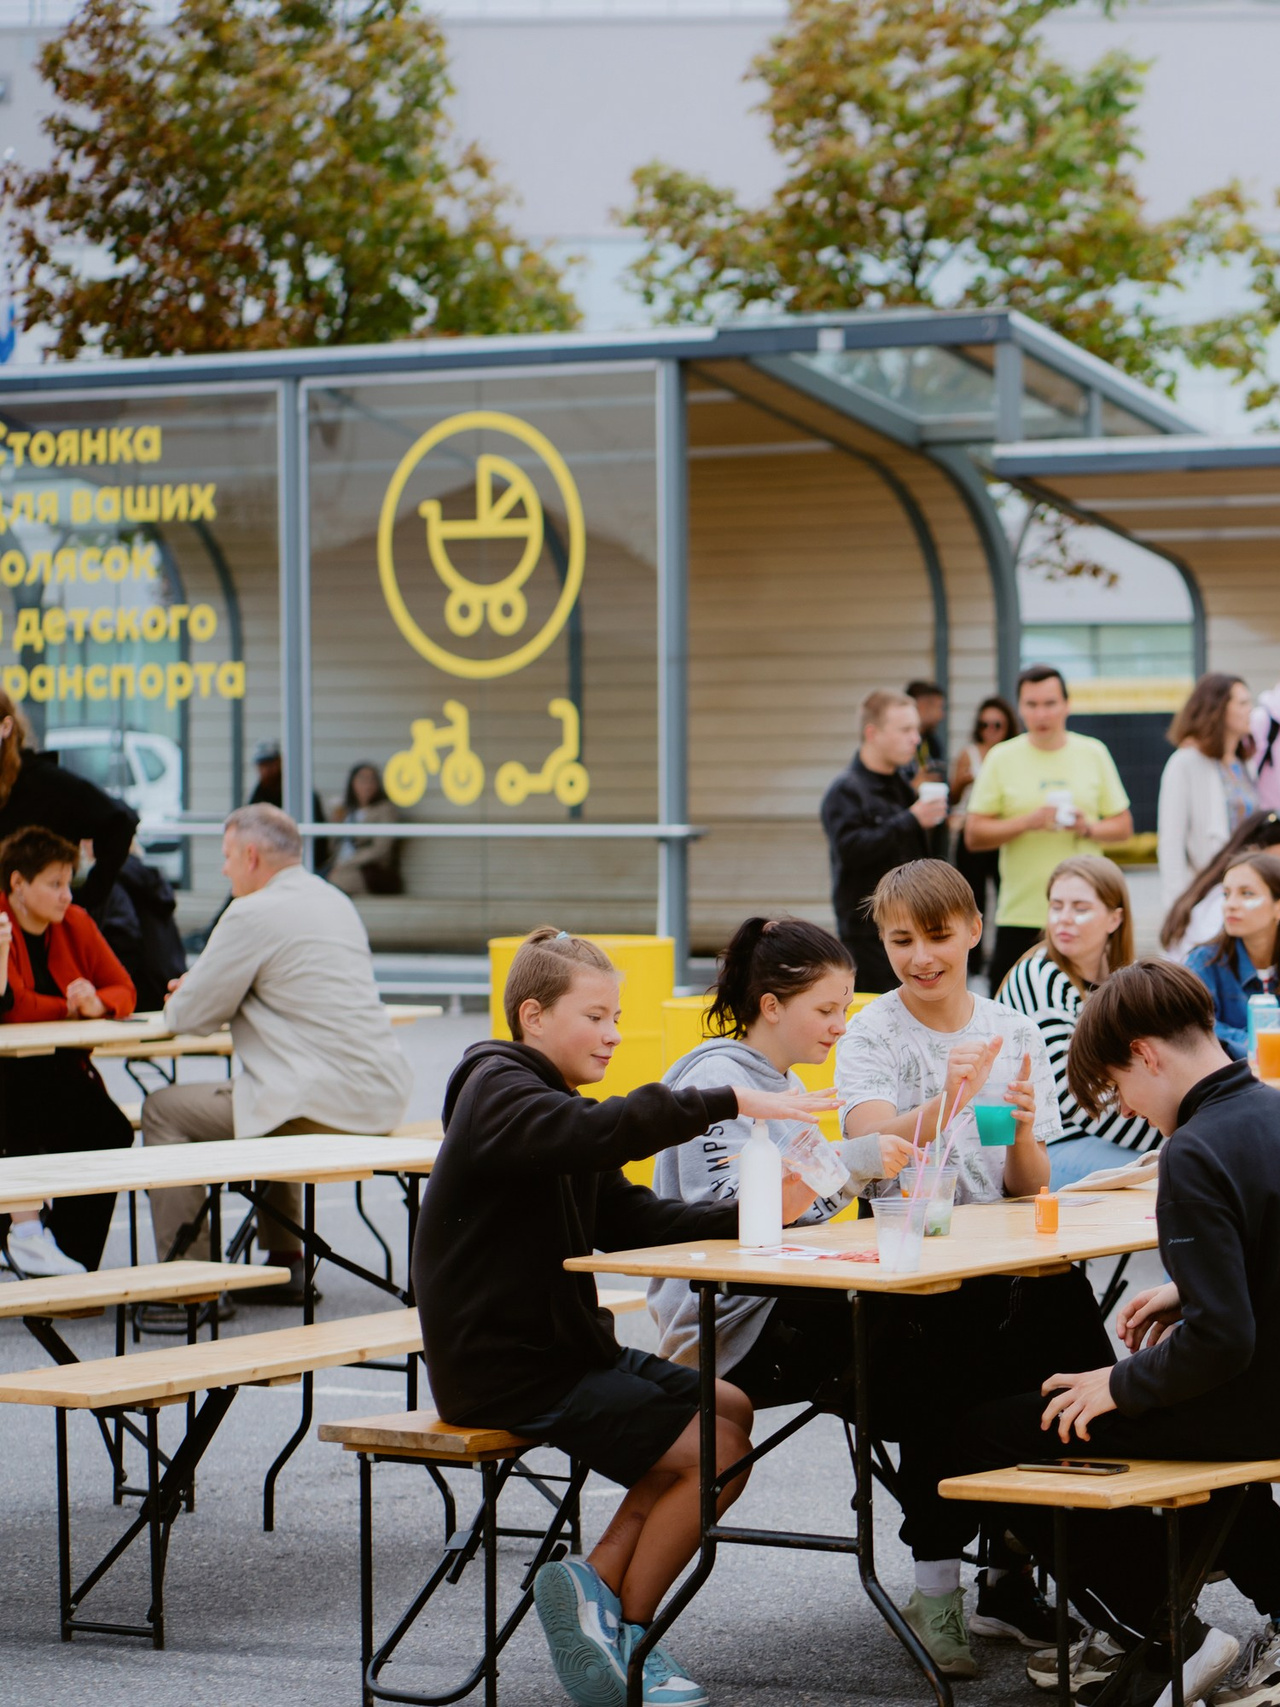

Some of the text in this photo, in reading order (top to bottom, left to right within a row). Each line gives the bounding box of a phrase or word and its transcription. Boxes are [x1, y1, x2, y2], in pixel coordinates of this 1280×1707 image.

[0, 483, 216, 535] ля ваших
[13, 603, 217, 652] детского
